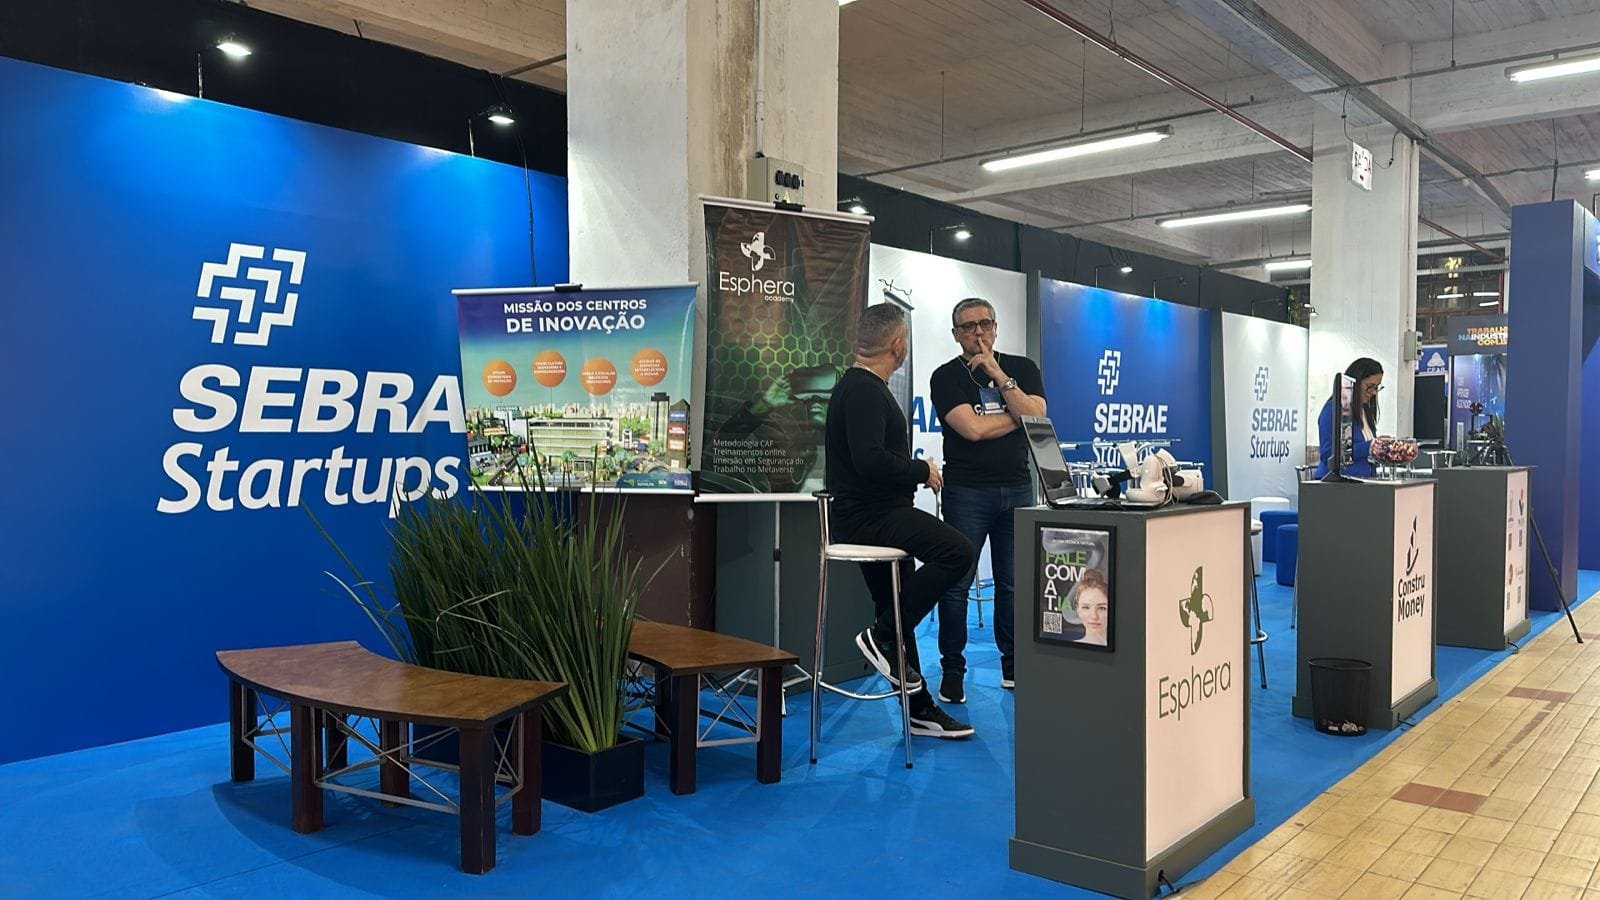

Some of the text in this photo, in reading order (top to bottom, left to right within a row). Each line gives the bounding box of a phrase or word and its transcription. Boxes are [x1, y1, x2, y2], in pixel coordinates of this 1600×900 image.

[719, 271, 795, 296] Esphera
[503, 299, 647, 314] MISSÃO DOS CENTROS
[764, 295, 794, 304] academy
[506, 311, 646, 334] DE INOVAÇÃO
[1094, 403, 1168, 434] SEBRAE
[1252, 407, 1298, 432] SEBRAE
[713, 439, 759, 448] Metodologia
[713, 448, 787, 457] Treinamentos online
[1250, 435, 1290, 463] Startups
[713, 456, 743, 465] Imersão
[757, 457, 794, 467] Segurança
[795, 457, 804, 465] do
[713, 465, 745, 473] Trabalho
[757, 465, 795, 474] Metaverso
[156, 442, 461, 519] Startups
[1045, 550, 1087, 567] FALE
[1045, 564, 1086, 582] COM
[1044, 580, 1058, 595] A
[1398, 573, 1425, 598] Constru
[1398, 594, 1425, 622] Money
[1159, 661, 1231, 721] Esphera
